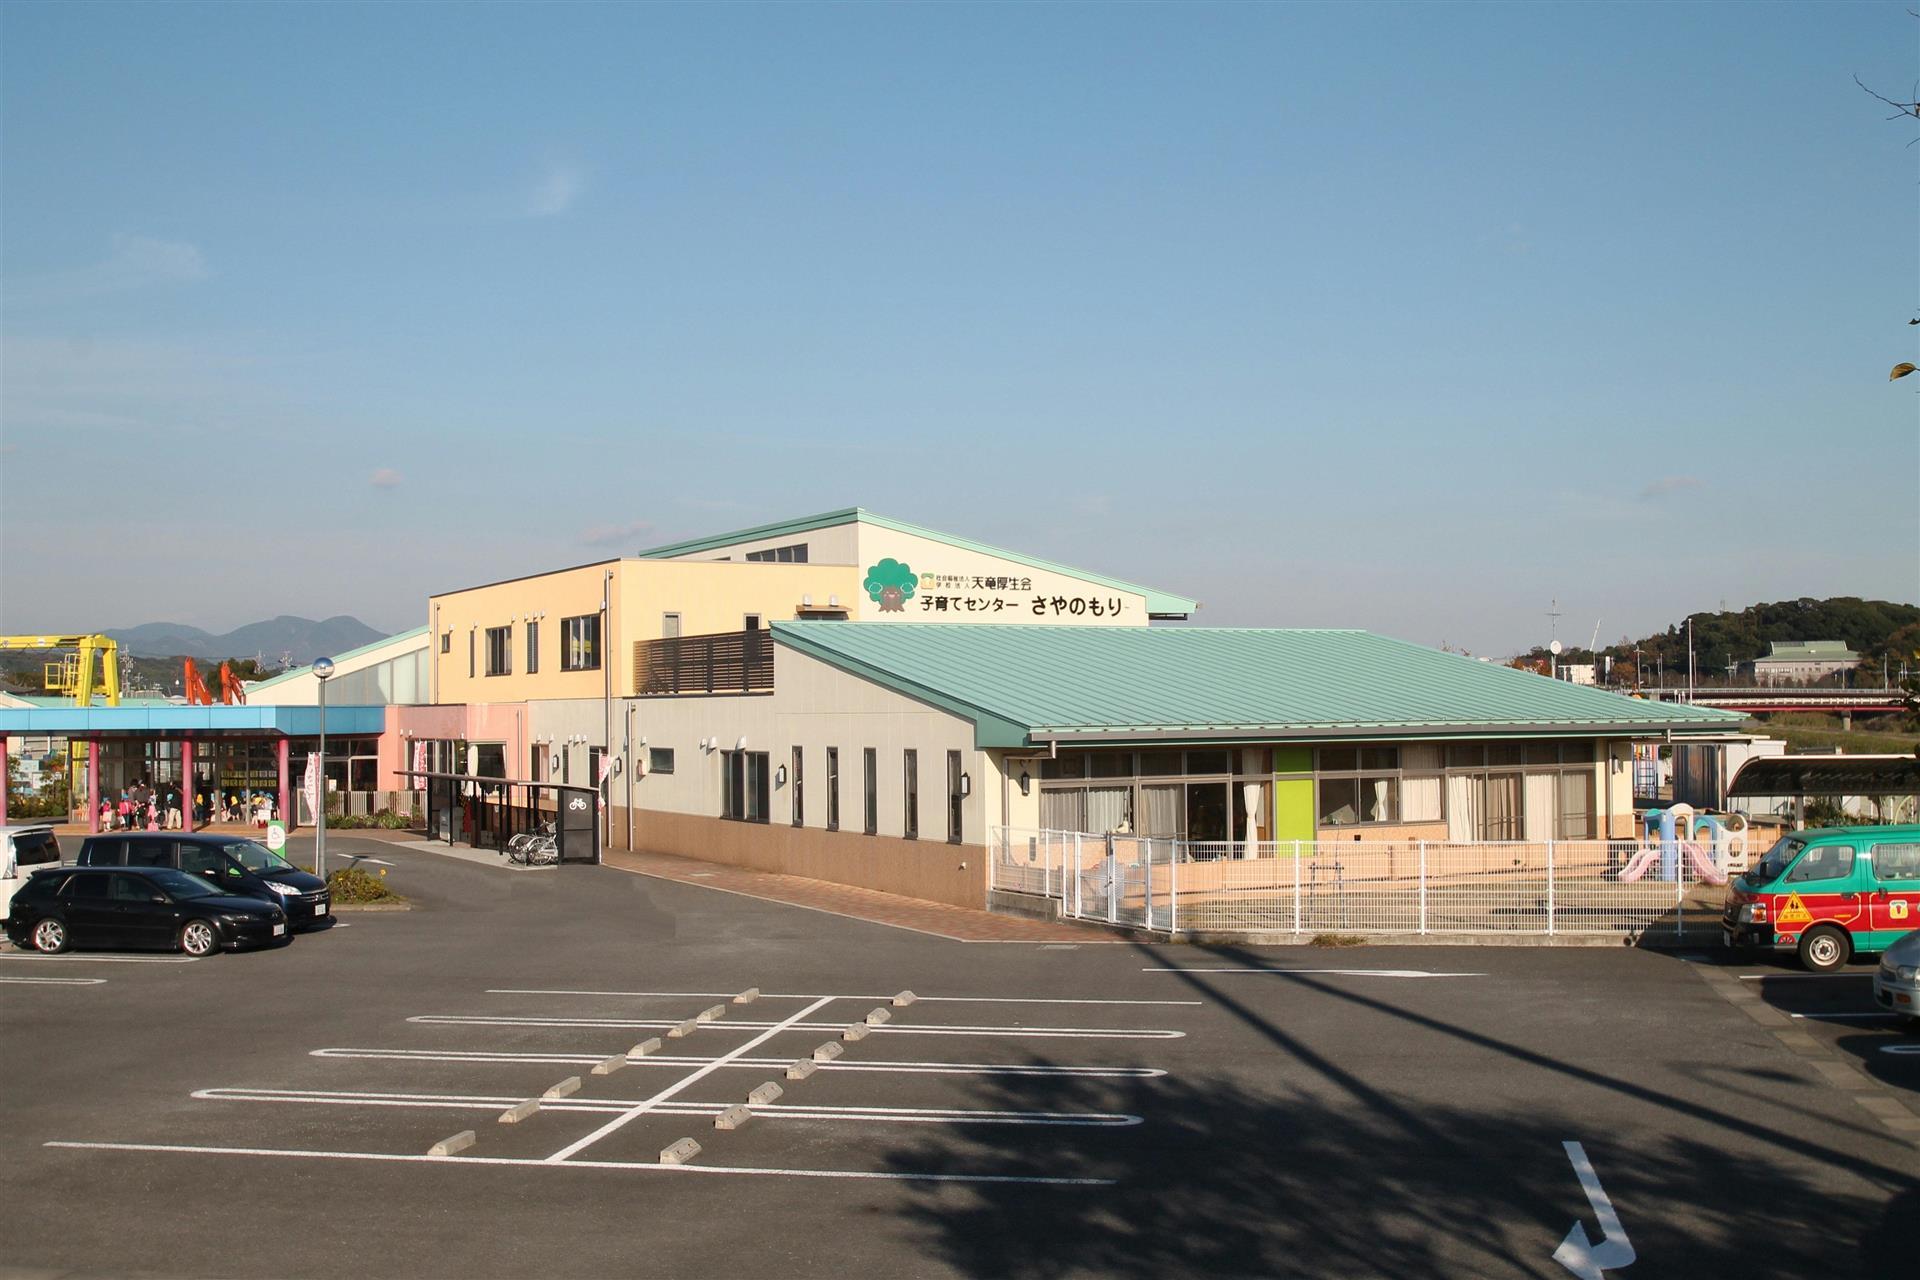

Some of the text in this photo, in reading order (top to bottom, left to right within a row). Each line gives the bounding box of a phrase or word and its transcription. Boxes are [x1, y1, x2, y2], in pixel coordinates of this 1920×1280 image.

[972, 576, 1032, 591] 天竜厚生会
[920, 595, 1122, 617] 子育てセンター さやのもり
